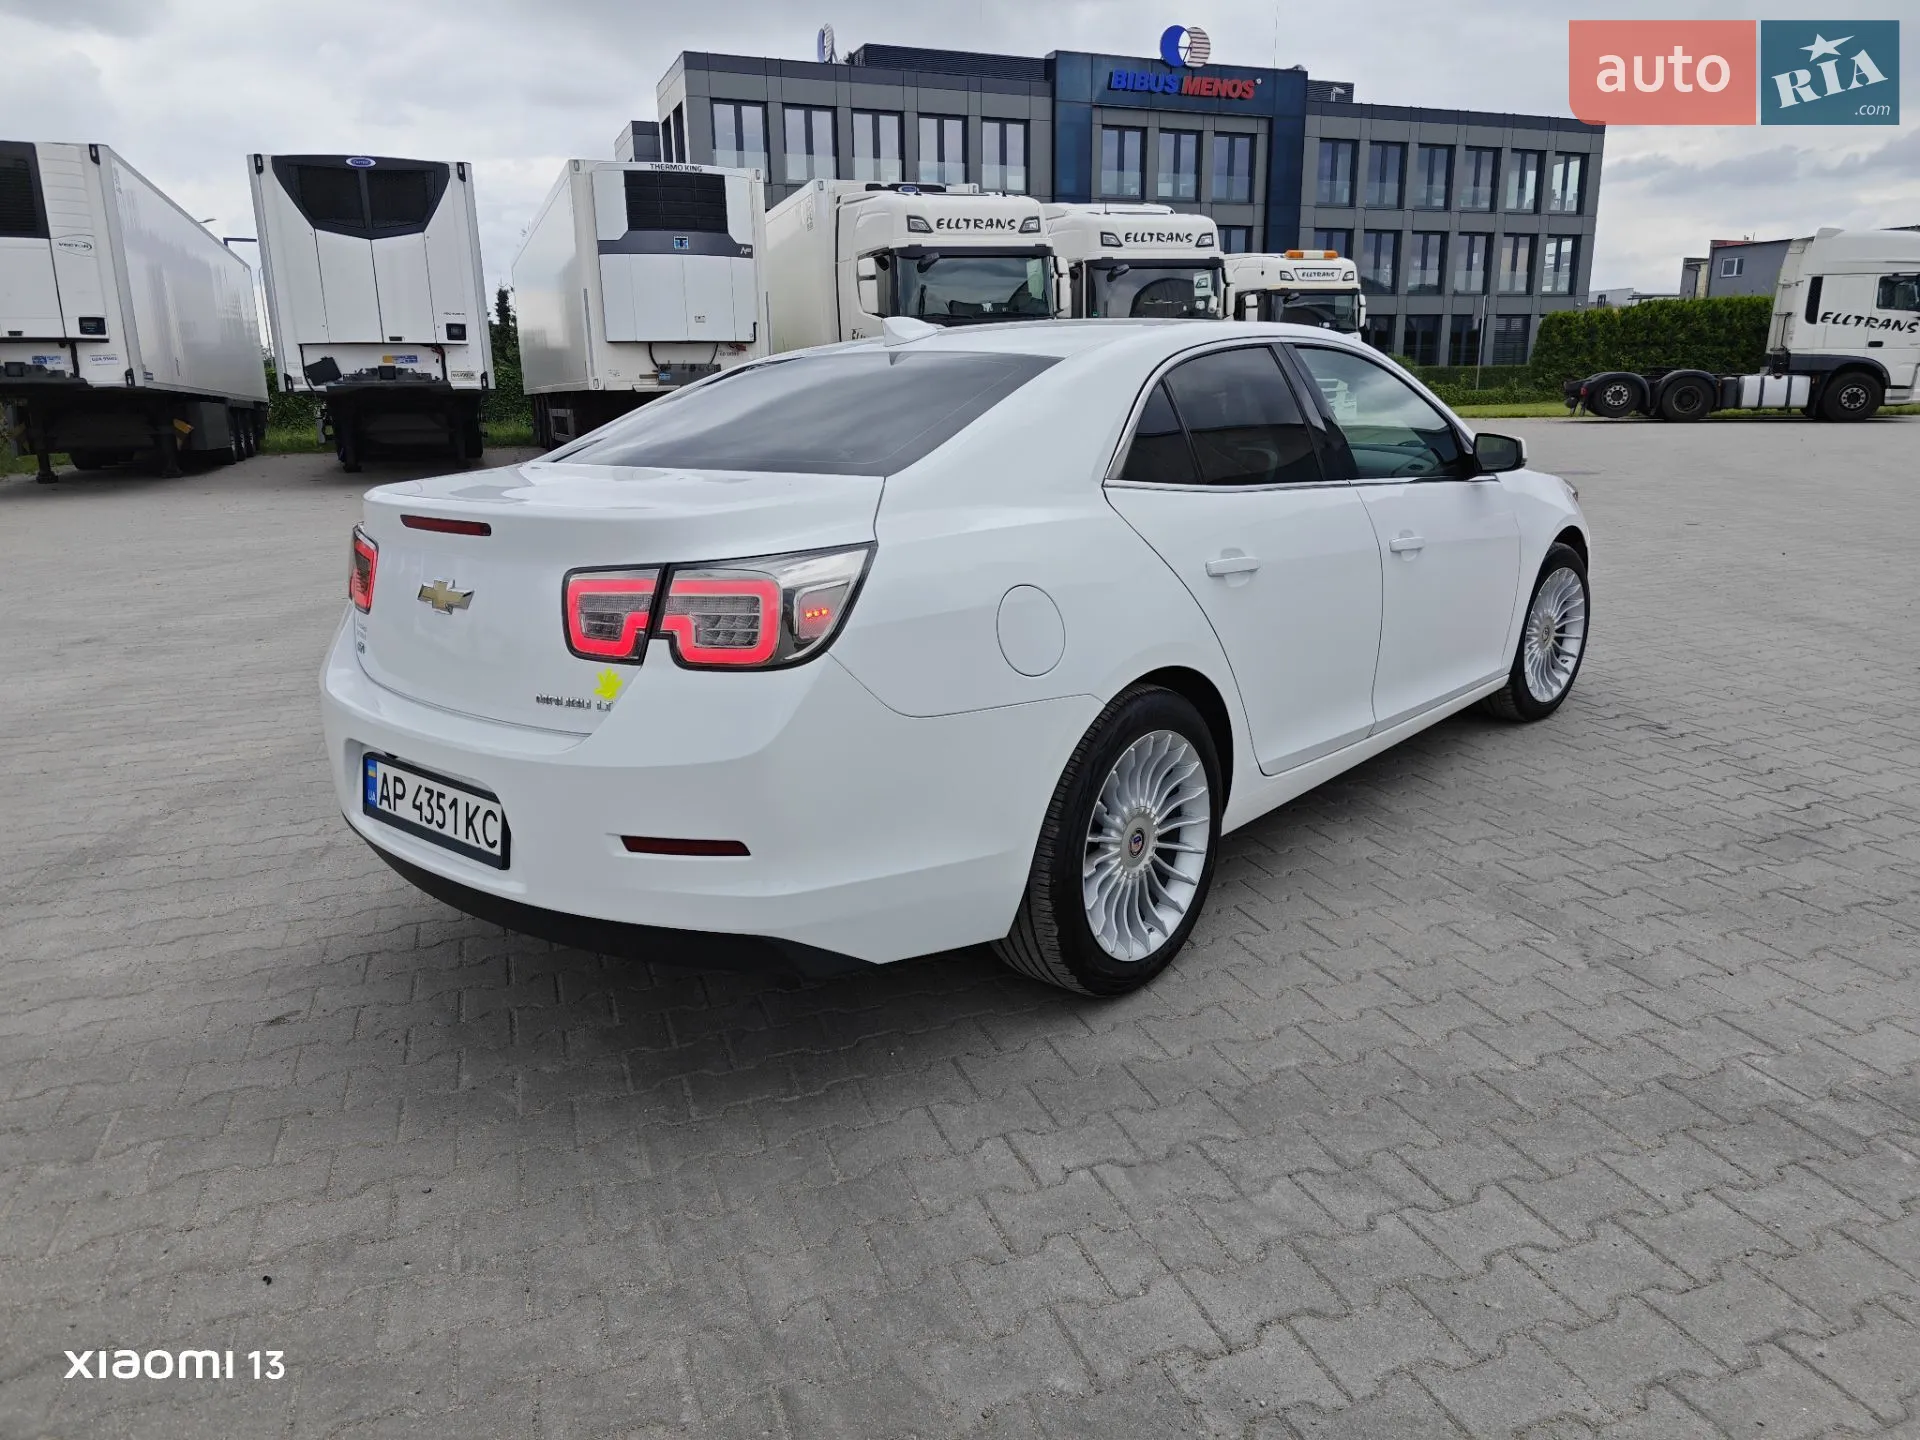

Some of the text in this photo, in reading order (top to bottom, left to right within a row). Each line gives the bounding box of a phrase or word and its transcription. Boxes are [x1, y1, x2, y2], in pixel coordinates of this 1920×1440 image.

[1109, 68, 1255, 100] BIBUS MENOS
[650, 163, 703, 172] THERMO KING
[936, 217, 1016, 231] ELLTRANS
[1124, 232, 1193, 243] ELLTRANS
[1820, 311, 1919, 334] ELLTRANS
[379, 772, 498, 848] AP 4351 KC
